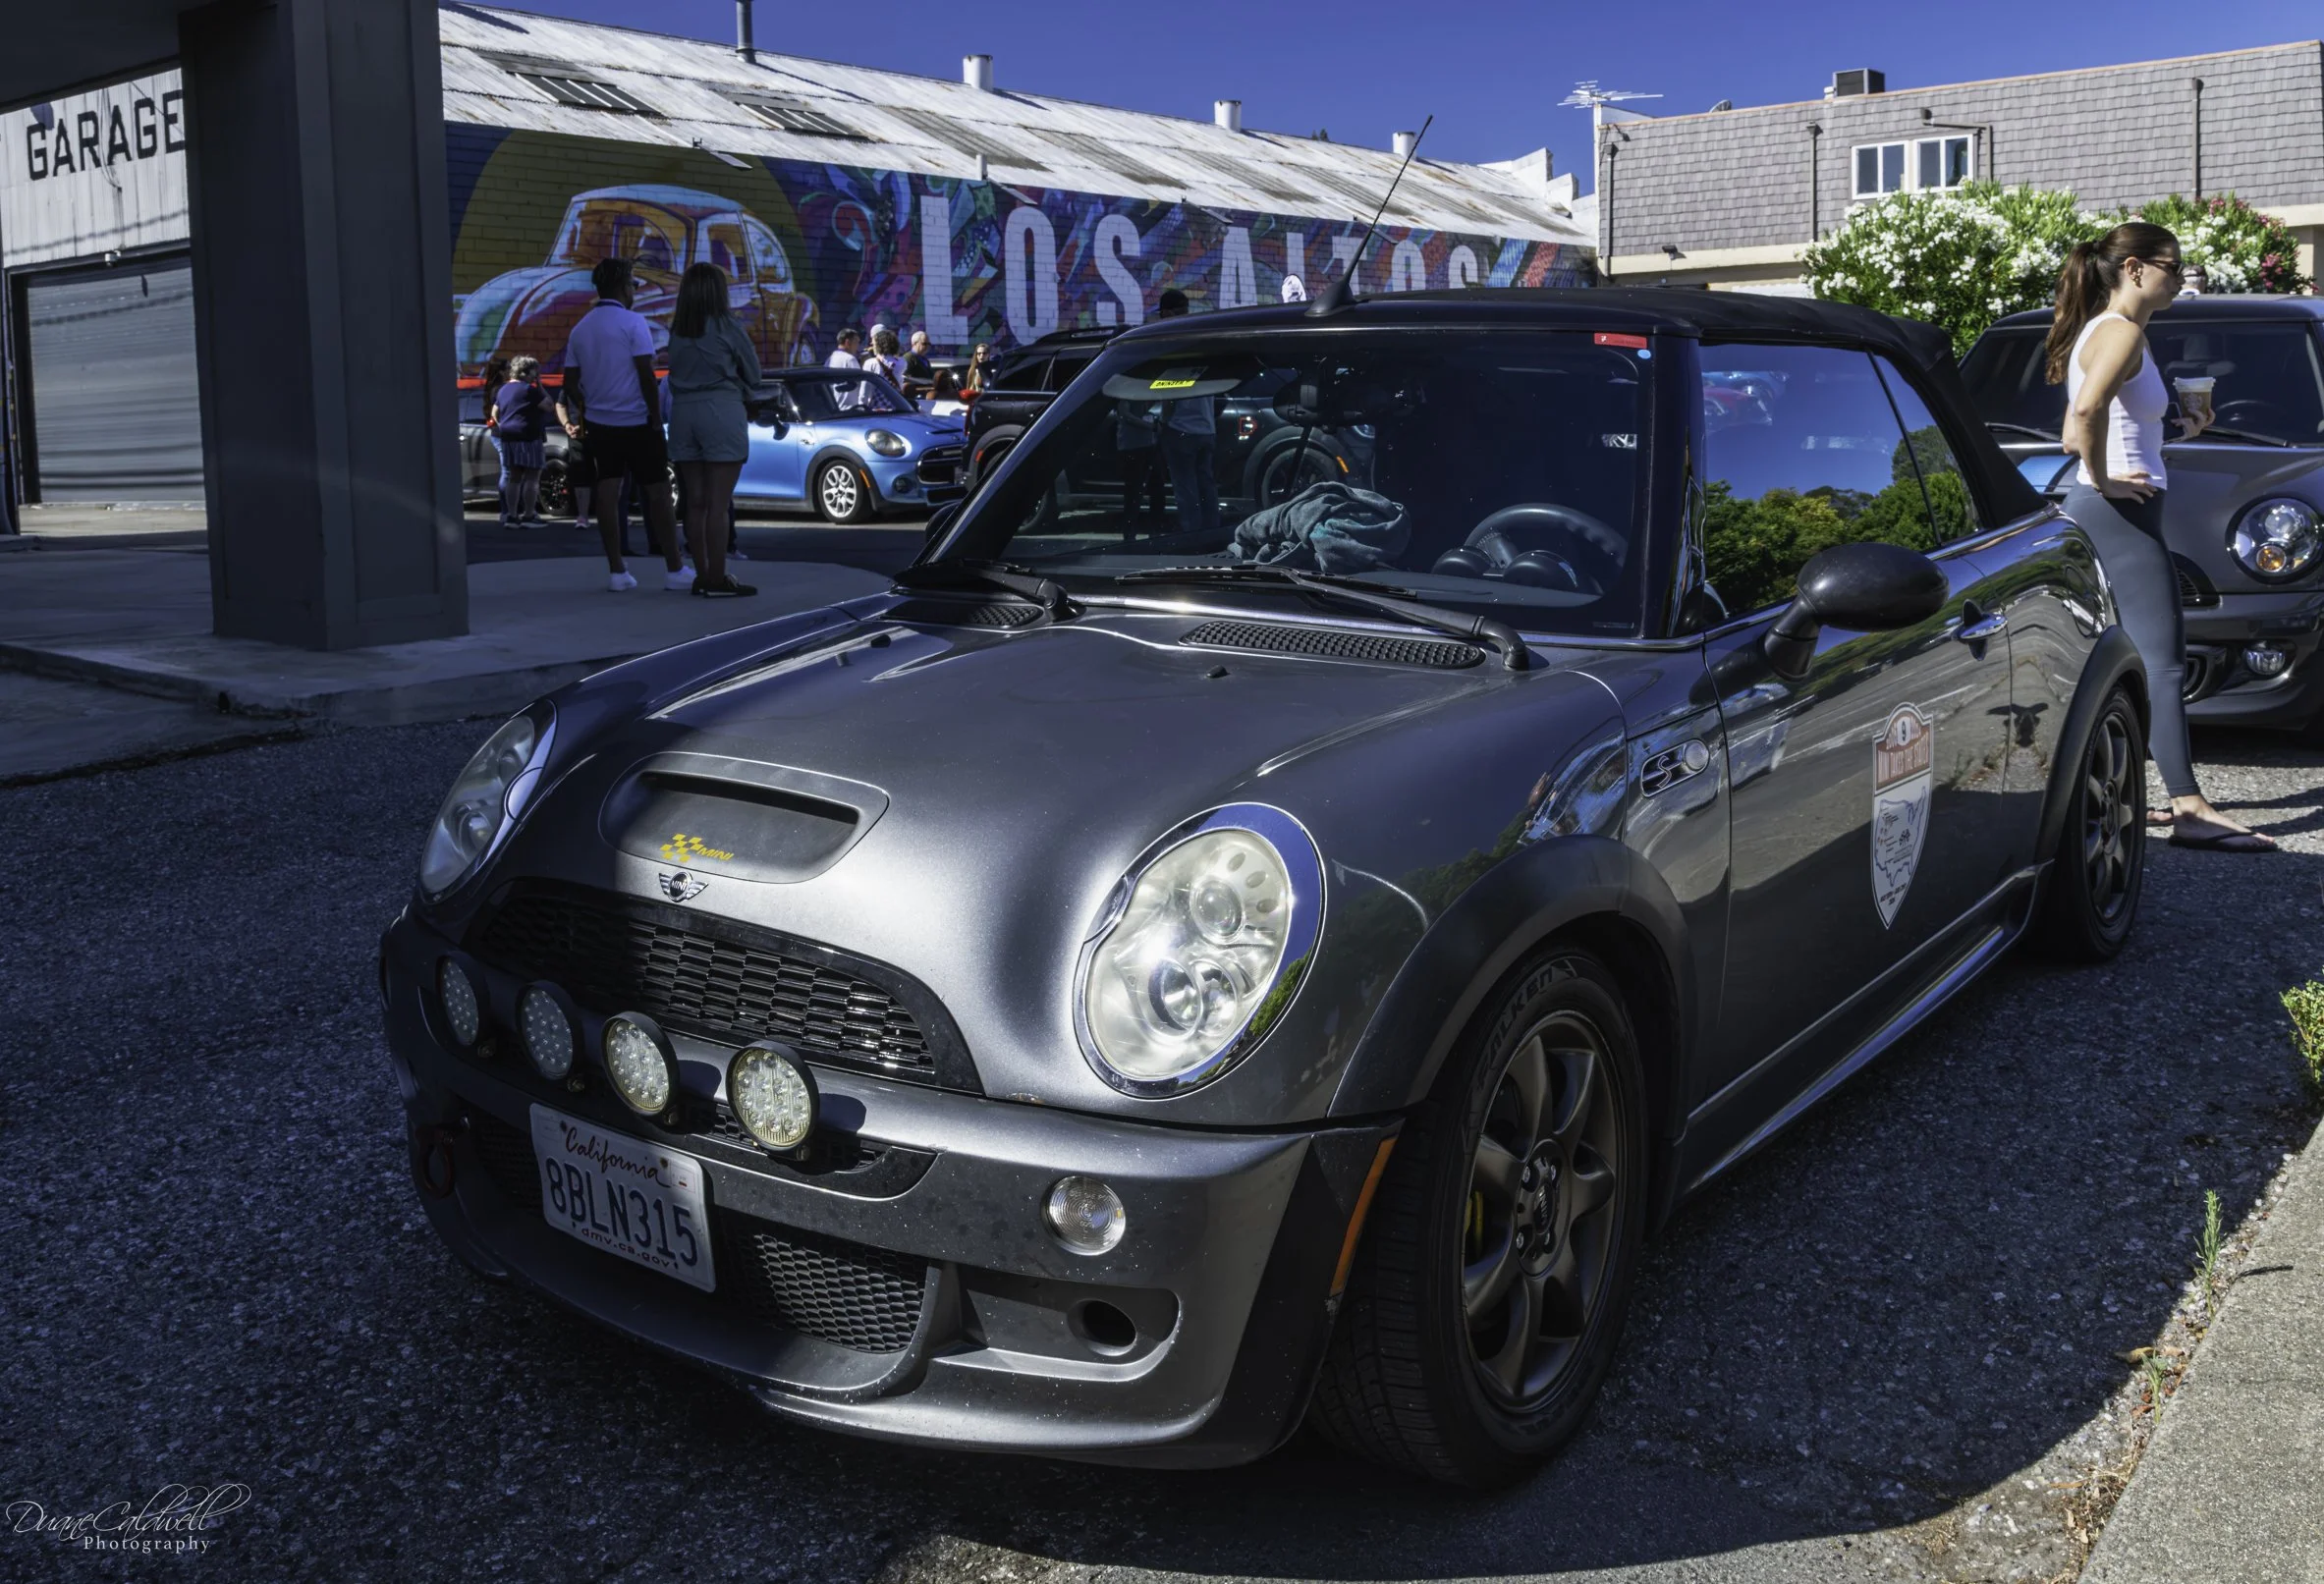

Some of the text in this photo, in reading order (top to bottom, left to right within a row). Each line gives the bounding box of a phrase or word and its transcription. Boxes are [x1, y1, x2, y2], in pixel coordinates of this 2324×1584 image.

[27, 89, 186, 181] GARAGE
[920, 195, 1143, 345] LOS
[696, 847, 734, 860] MINI
[672, 880, 688, 891] MINI
[565, 1128, 670, 1188] California
[547, 1158, 697, 1267] 8BLN315
[581, 1227, 670, 1268] dmv.ca.gov
